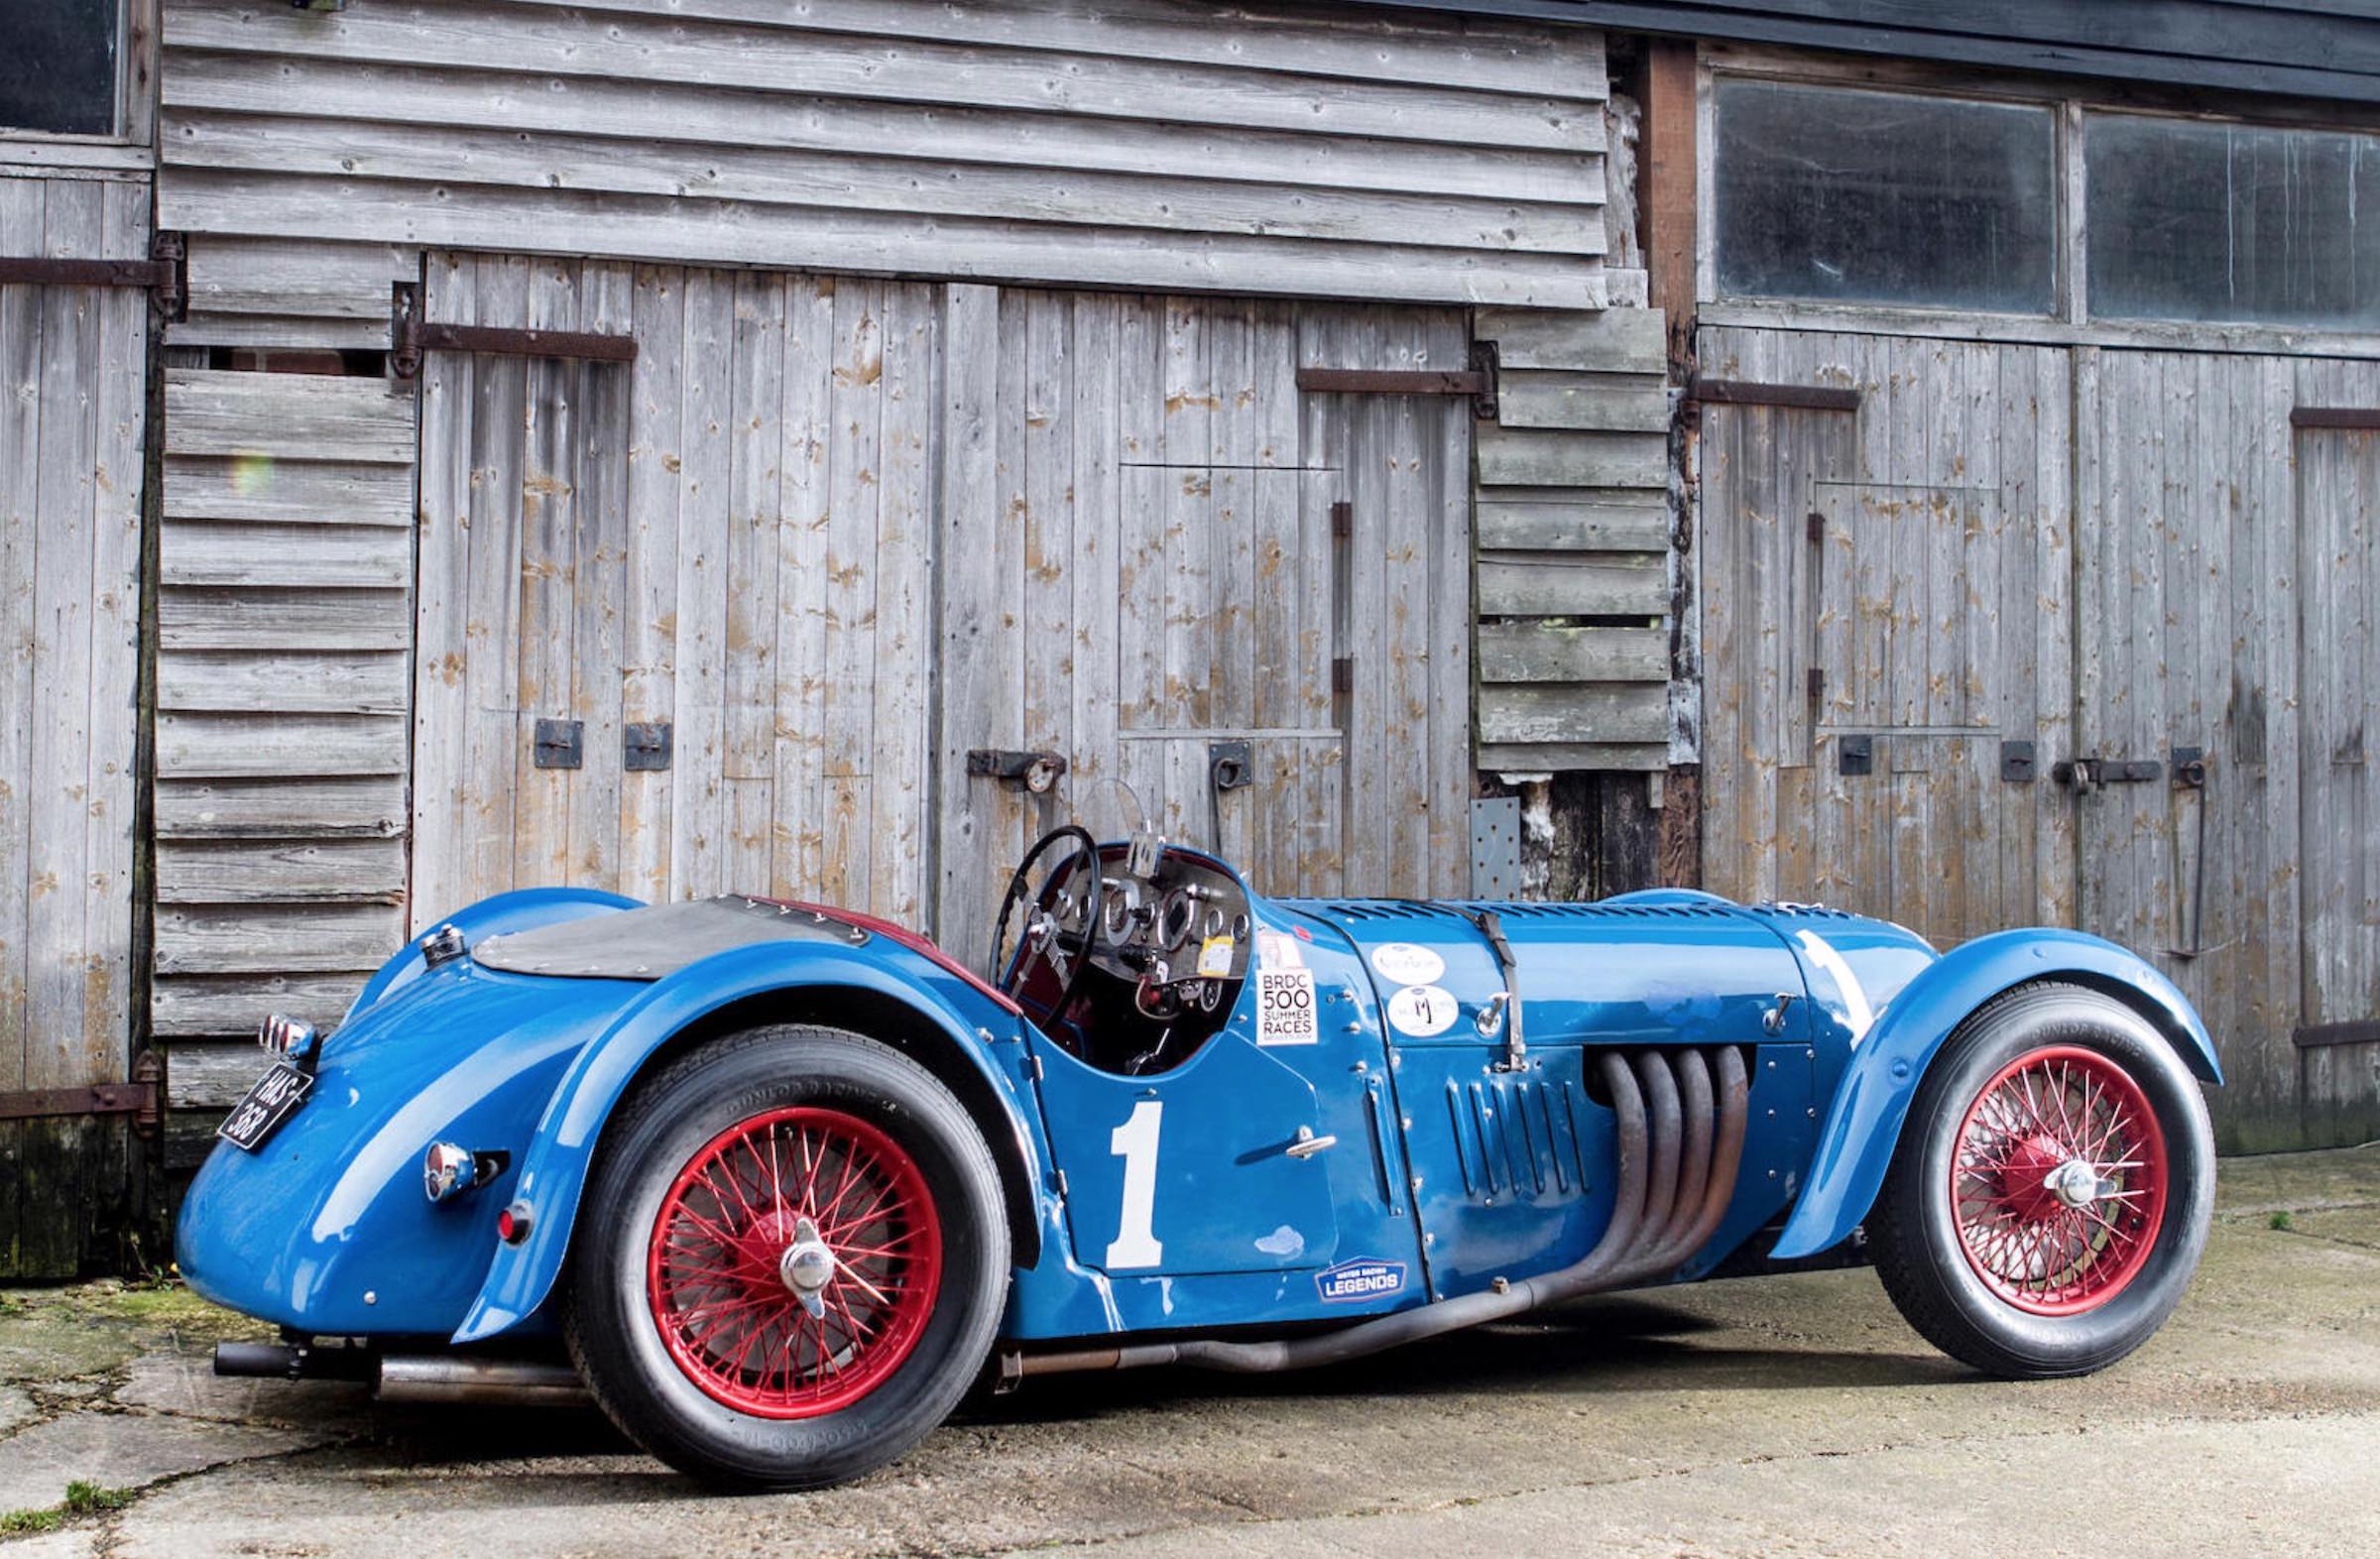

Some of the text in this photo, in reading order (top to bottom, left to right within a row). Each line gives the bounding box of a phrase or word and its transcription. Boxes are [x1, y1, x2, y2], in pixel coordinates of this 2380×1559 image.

[1263, 974, 1307, 989] BRDC
[1263, 989, 1310, 1010] 500
[1263, 1010, 1310, 1020] SUMMER
[1263, 1020, 1312, 1034] RACES
[227, 1102, 269, 1140] 368
[1106, 1101, 1163, 1268] 1
[1326, 1273, 1398, 1296] LEGENDS
